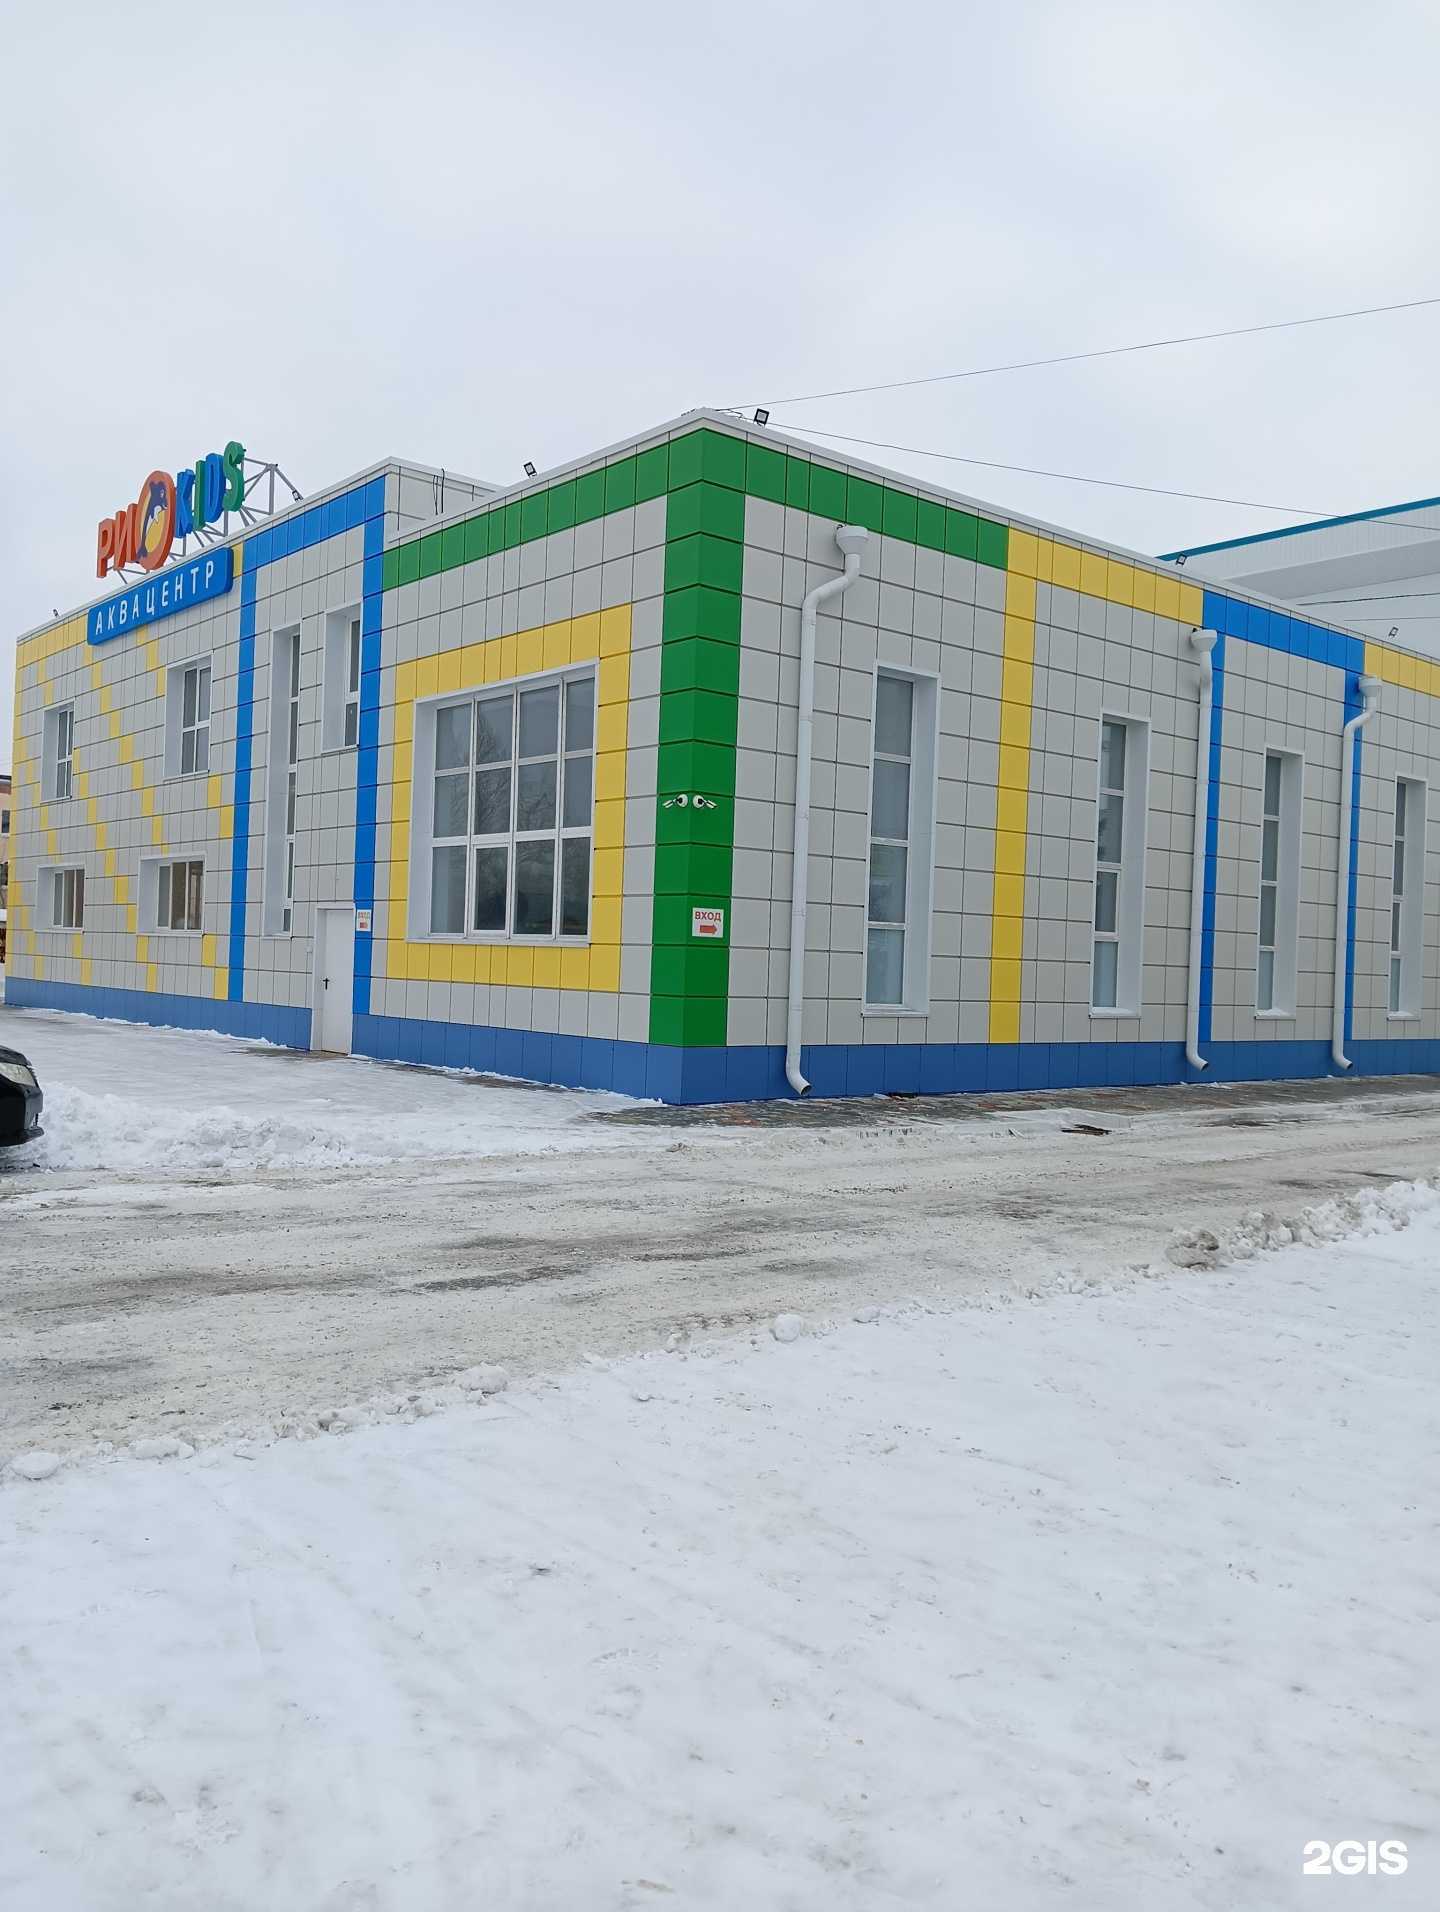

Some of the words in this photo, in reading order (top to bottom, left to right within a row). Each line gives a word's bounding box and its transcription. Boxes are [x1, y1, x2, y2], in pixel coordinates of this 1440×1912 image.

[175, 441, 245, 538] KIDS
[95, 561, 214, 635] АКВАЦЕНТР
[695, 911, 721, 922] ВХОД
